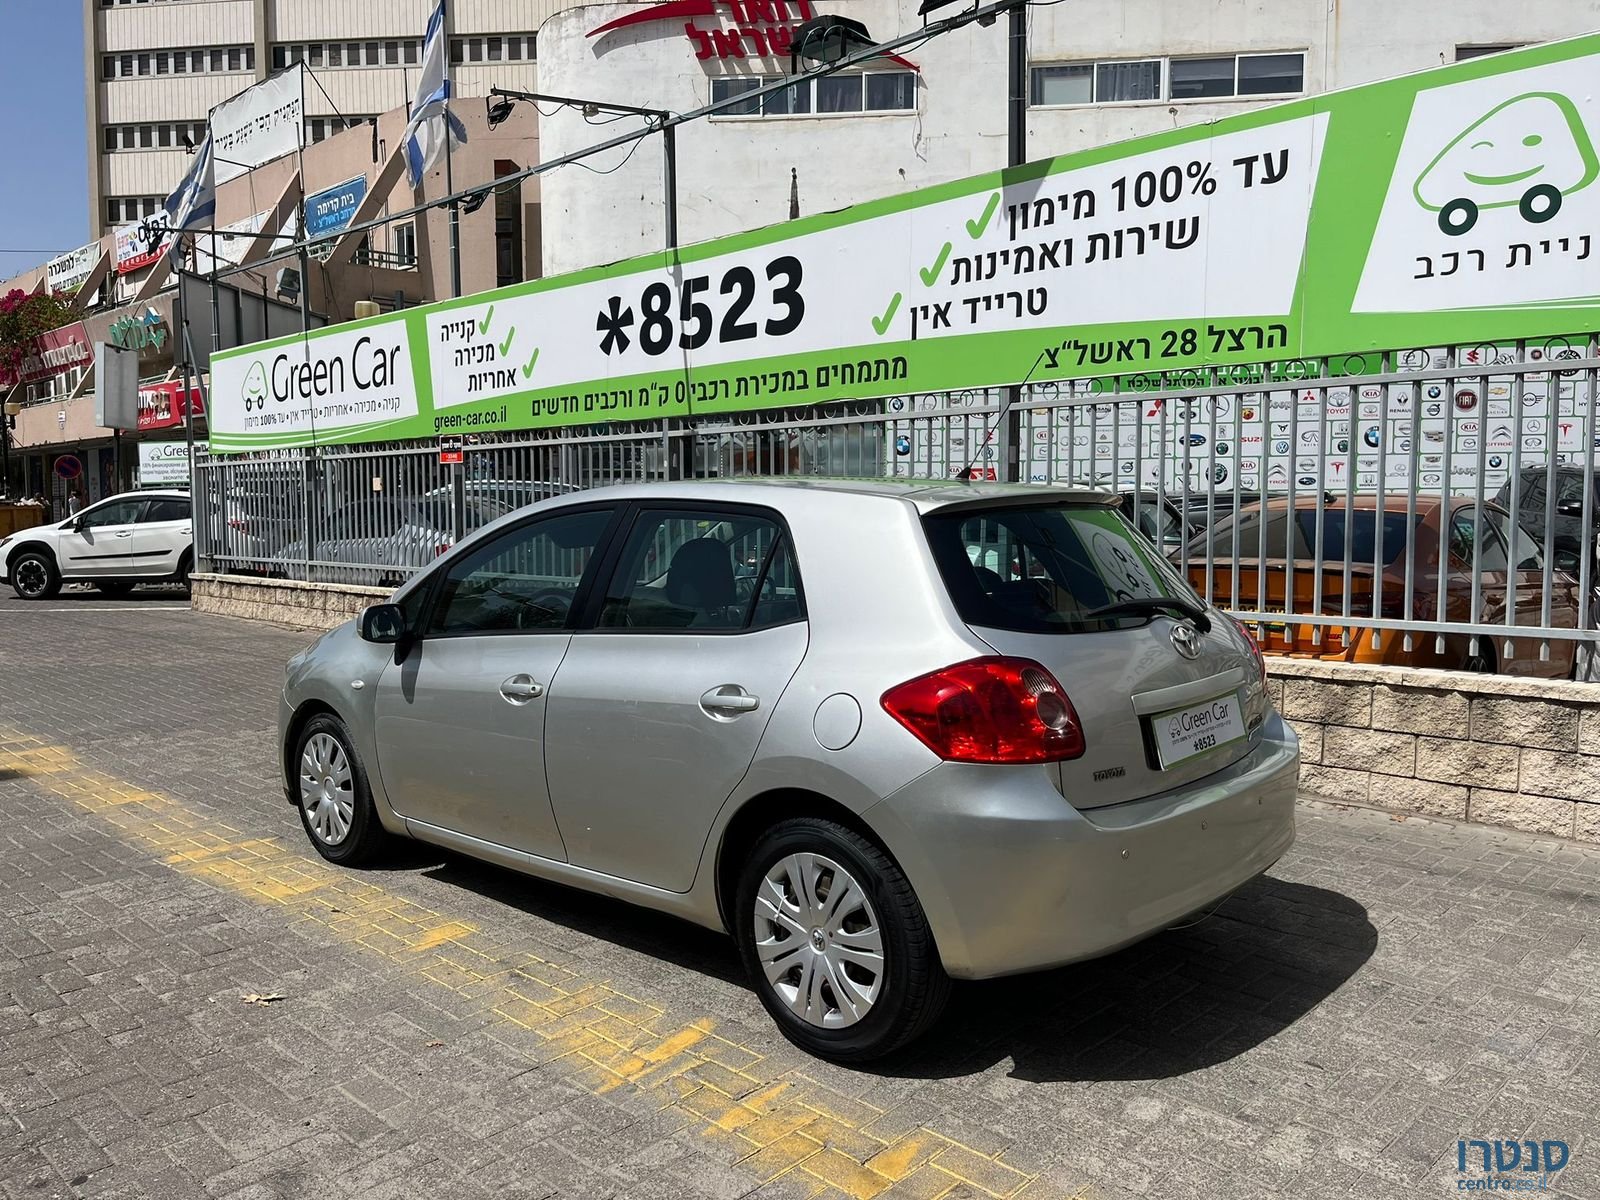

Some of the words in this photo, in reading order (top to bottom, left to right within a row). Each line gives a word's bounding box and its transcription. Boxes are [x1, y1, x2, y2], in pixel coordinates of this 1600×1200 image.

[684, 22, 798, 59] שראל
[1233, 149, 1289, 188] עד
[1111, 160, 1216, 212] 100%
[341, 193, 355, 207] בית
[1007, 189, 1095, 241] מימון
[1085, 215, 1200, 264] שירות
[48, 254, 75, 277] להשכרה
[951, 238, 1073, 285] ואמינות
[1414, 249, 1485, 279] רכב
[963, 287, 1048, 324] טרייד
[441, 319, 475, 343] קנייה
[910, 300, 952, 340] אין
[1160, 329, 1198, 357] 28
[1208, 323, 1288, 353] הרצל
[455, 343, 495, 367] מכירה
[272, 353, 345, 402] Green
[352, 336, 401, 390] Car
[468, 368, 517, 393] אחריות
[816, 355, 908, 388] מתמחים
[690, 376, 730, 400] רכבי
[736, 368, 810, 398] במכירת
[324, 404, 349, 418] אחריות
[354, 399, 377, 415] מכירה
[382, 396, 400, 414] קניה
[531, 393, 579, 416] חדשים
[583, 387, 633, 411] ורכבים
[260, 413, 277, 425] 100%
[434, 405, 507, 432] green-car.co.il
[163, 445, 189, 457] Gree
[1182, 710, 1212, 731] Green
[1212, 702, 1229, 720] Car
[1093, 766, 1126, 782] TOYOTA
